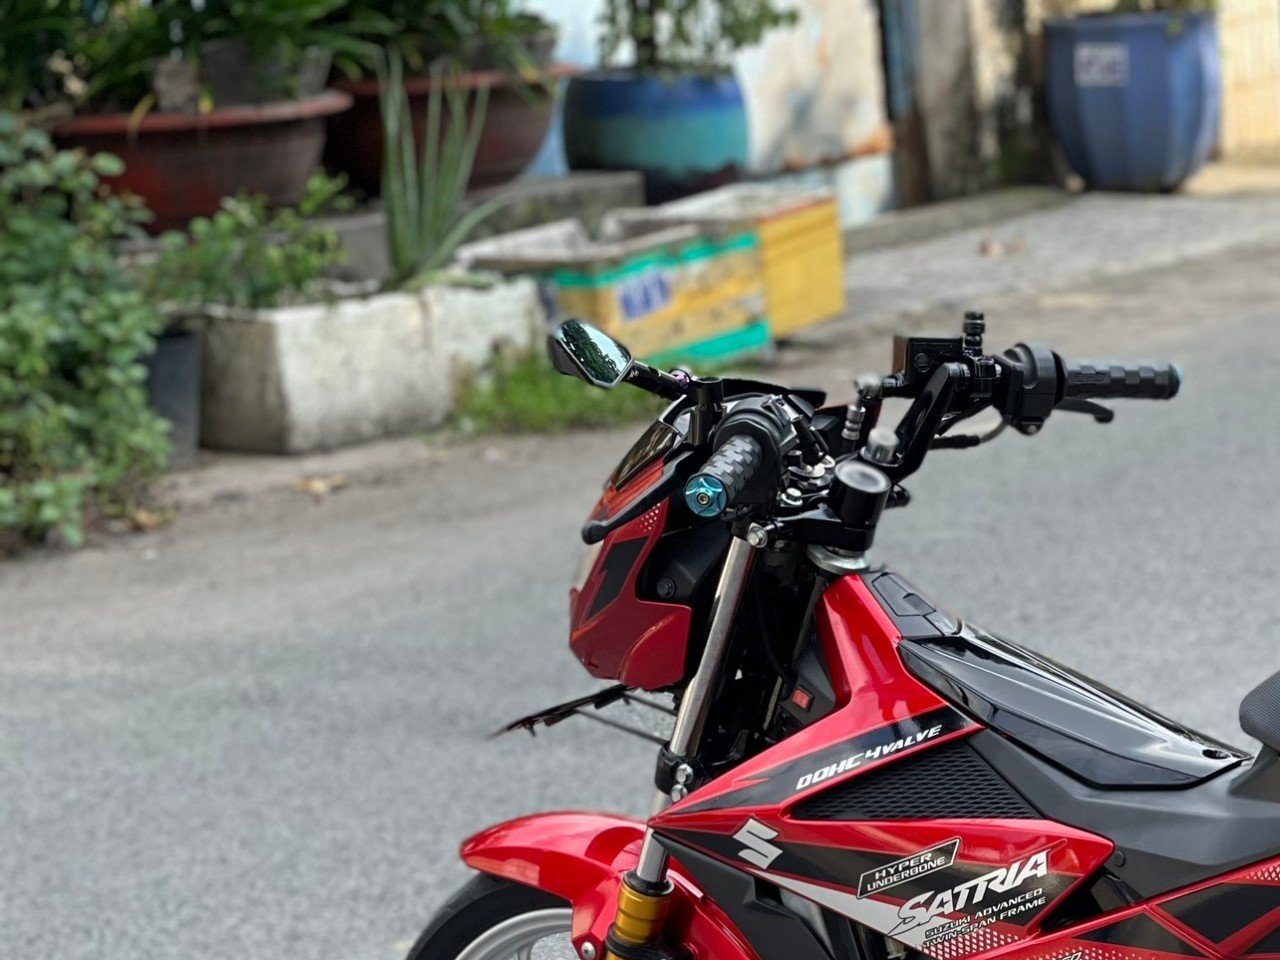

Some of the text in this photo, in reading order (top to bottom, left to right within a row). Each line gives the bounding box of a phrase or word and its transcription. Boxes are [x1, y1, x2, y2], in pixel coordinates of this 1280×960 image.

[796, 752, 865, 790] DOHC
[867, 856, 946, 892] UNDERBONE
[875, 853, 933, 879] HYPER
[888, 850, 1048, 935] SATRIA
[924, 887, 1043, 939] SUZUKI ADVANCED
[923, 897, 1046, 947] TWIN-SPAN FRAME
